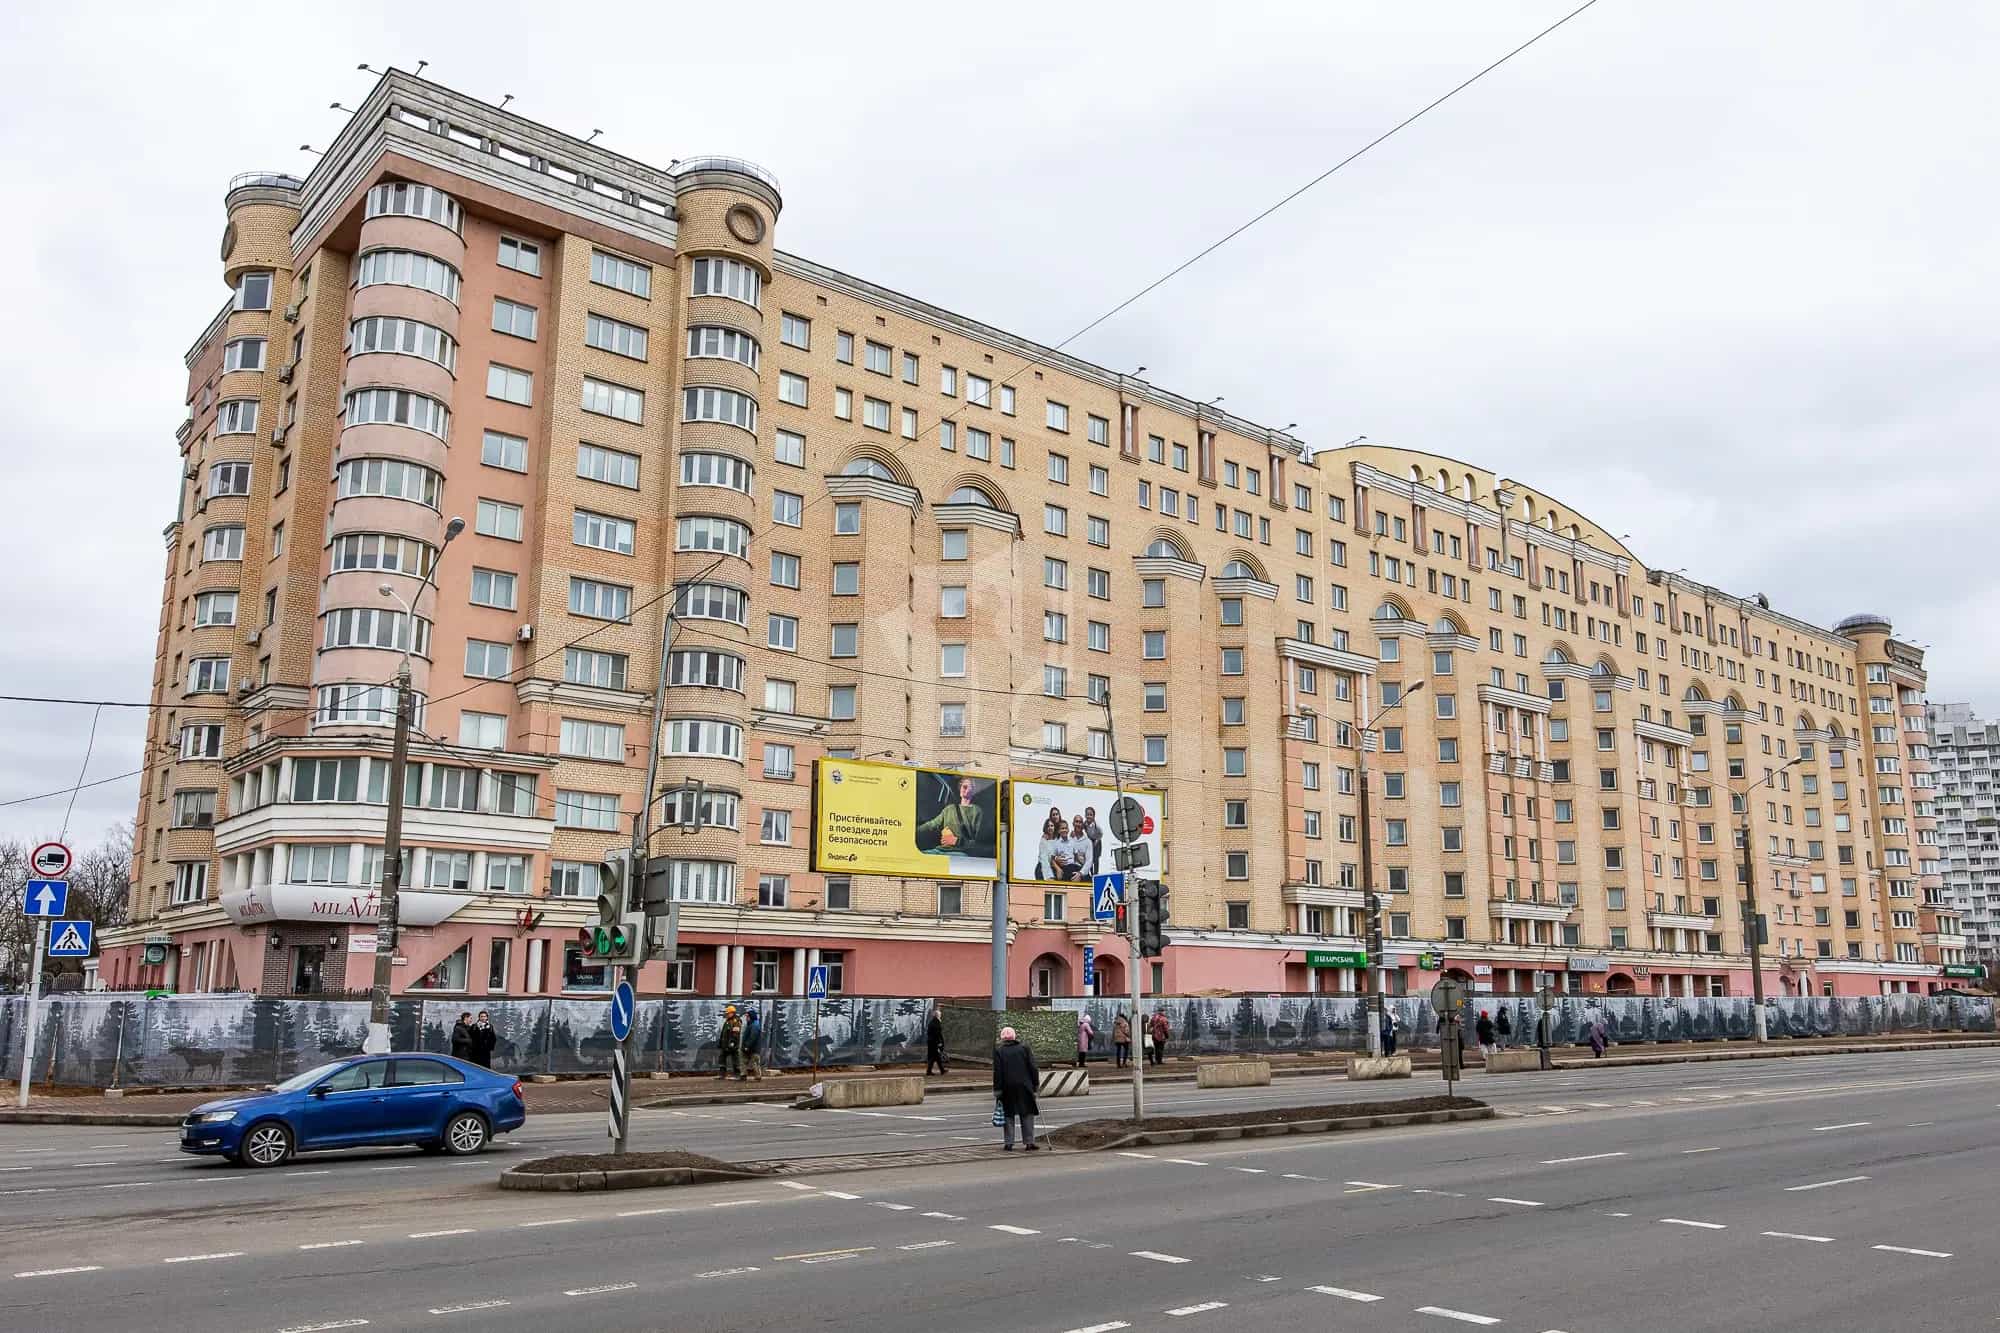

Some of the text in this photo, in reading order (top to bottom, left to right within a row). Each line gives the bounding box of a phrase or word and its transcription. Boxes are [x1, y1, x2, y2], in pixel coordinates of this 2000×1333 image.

[829, 812, 902, 827] Пристёгивайтесь
[836, 825, 871, 835] поездке
[828, 834, 888, 846] безопасности
[311, 896, 380, 918] MILAVIT
